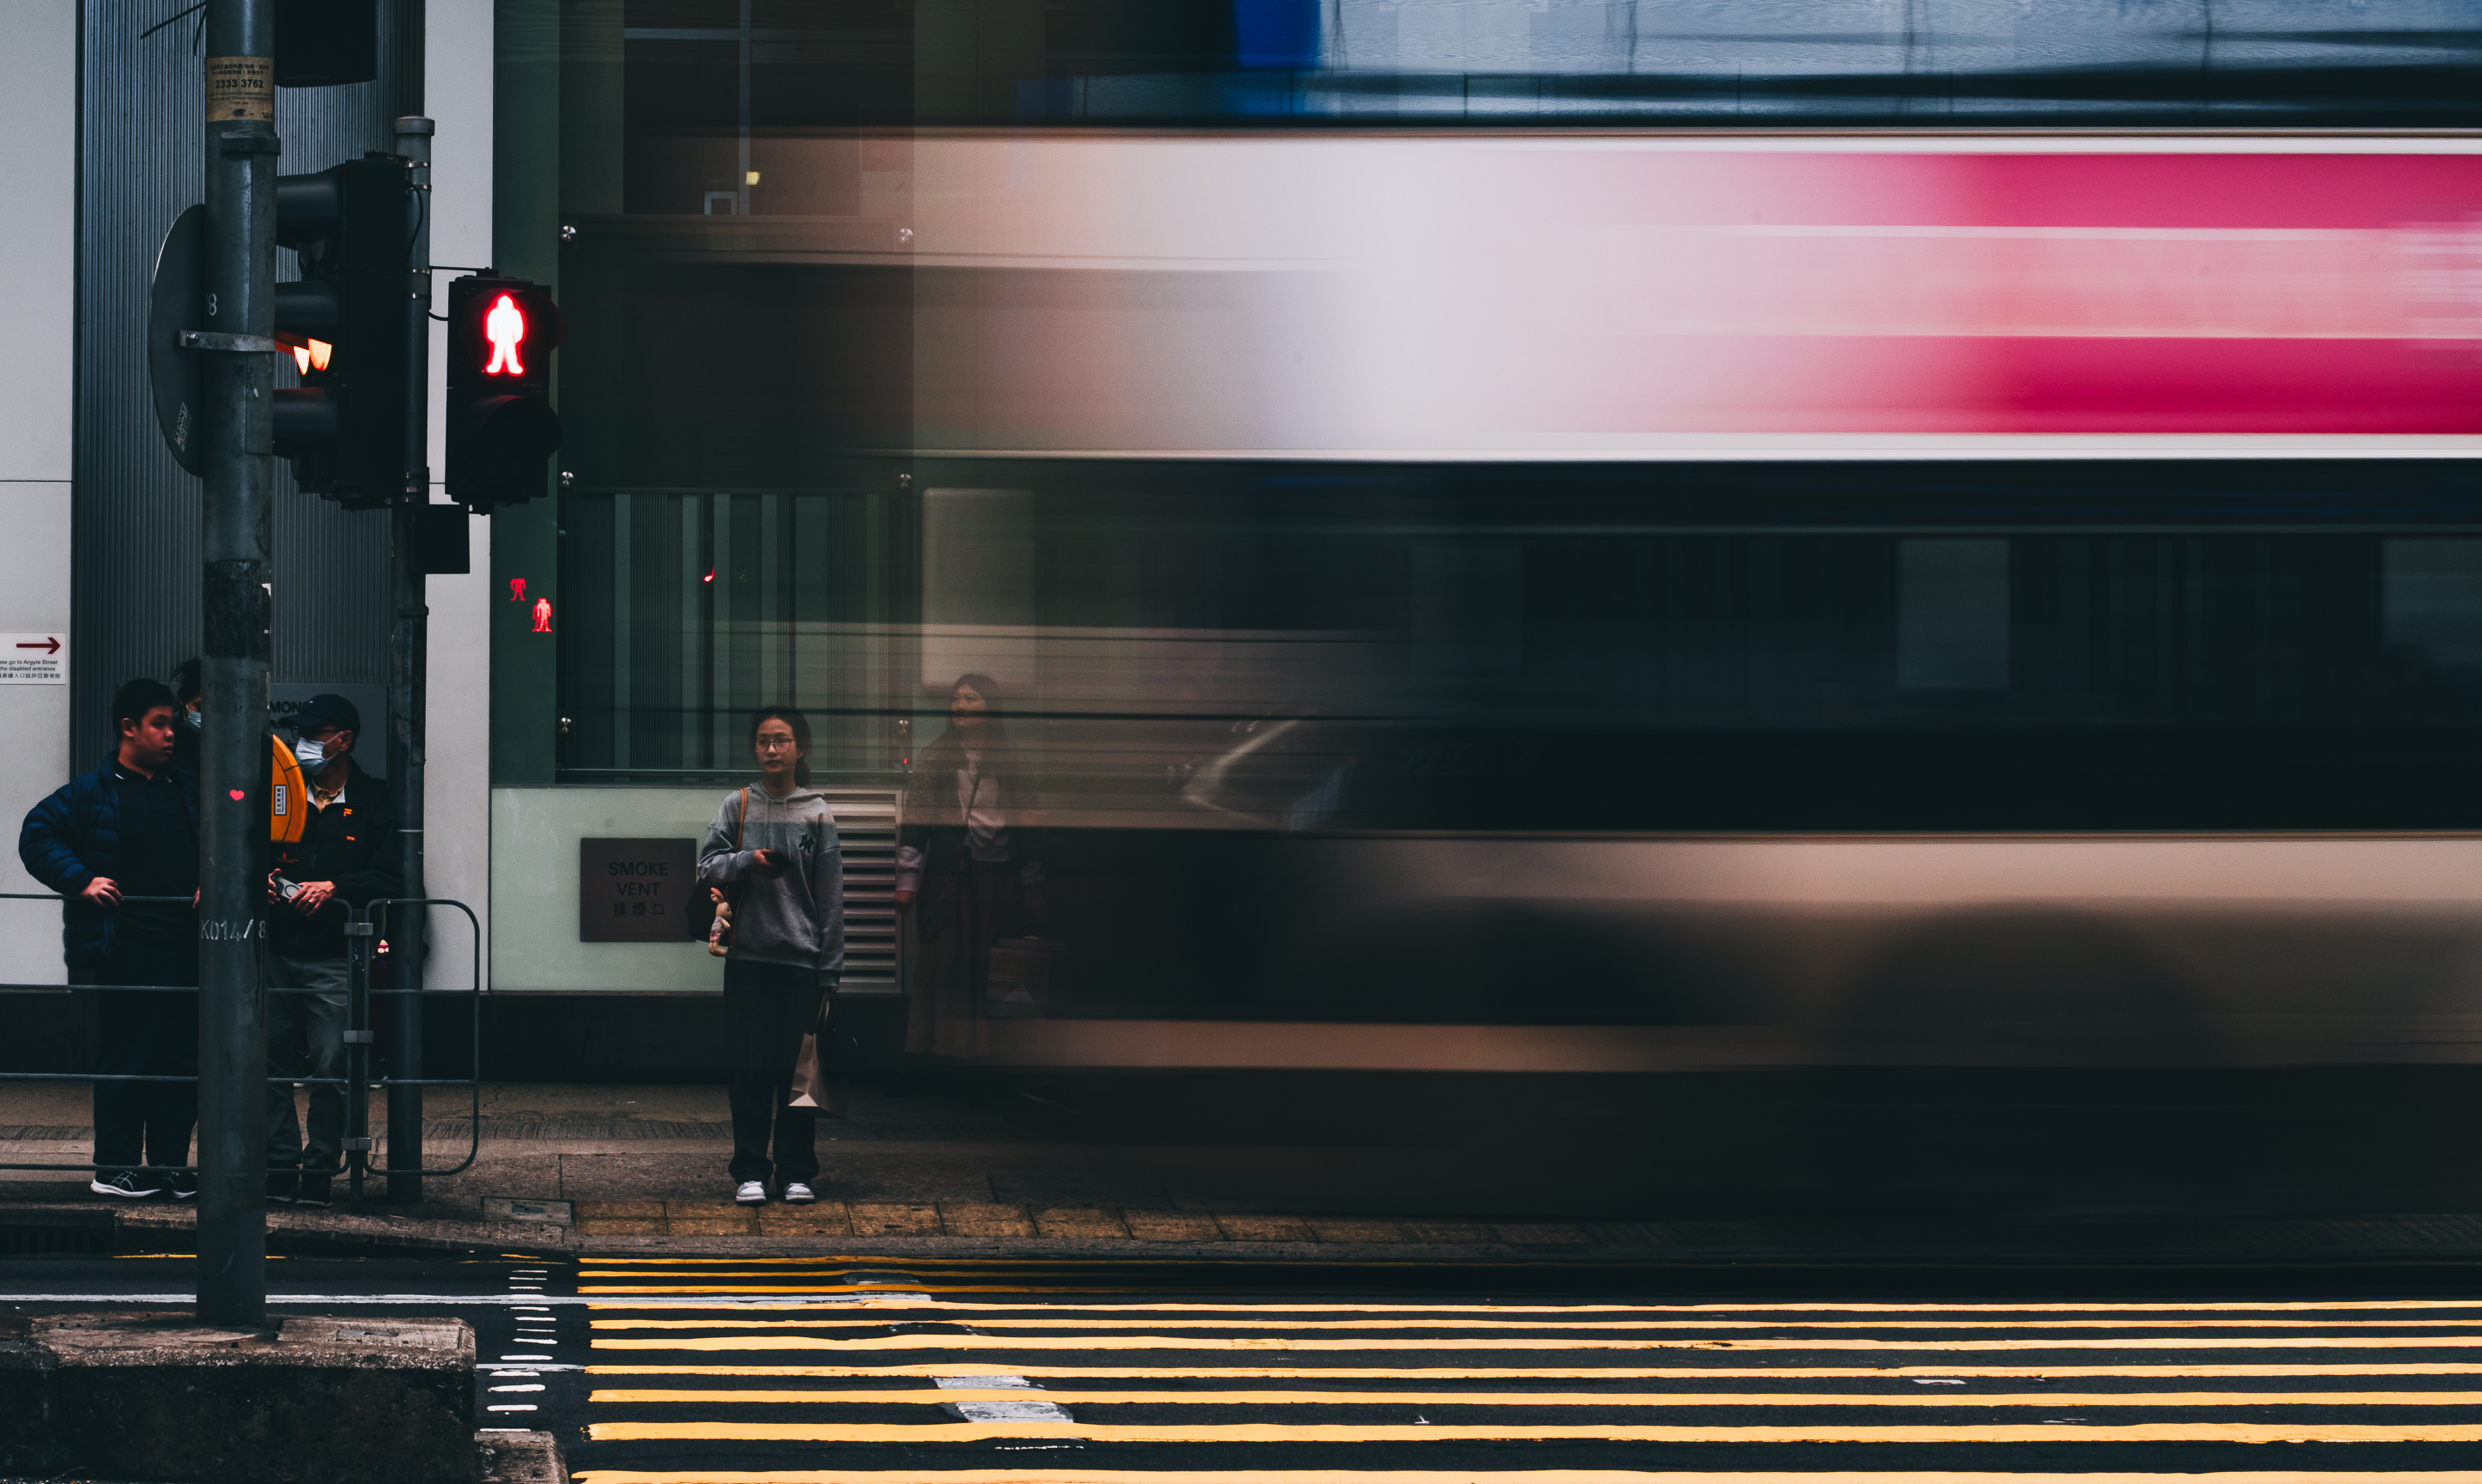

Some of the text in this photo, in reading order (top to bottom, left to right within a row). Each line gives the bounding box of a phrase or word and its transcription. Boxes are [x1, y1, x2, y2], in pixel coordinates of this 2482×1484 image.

[215, 79, 264, 88] 2333 3762
[608, 862, 669, 875] SMOKE
[616, 882, 661, 896] VENT
[613, 901, 664, 917] 排煙口
